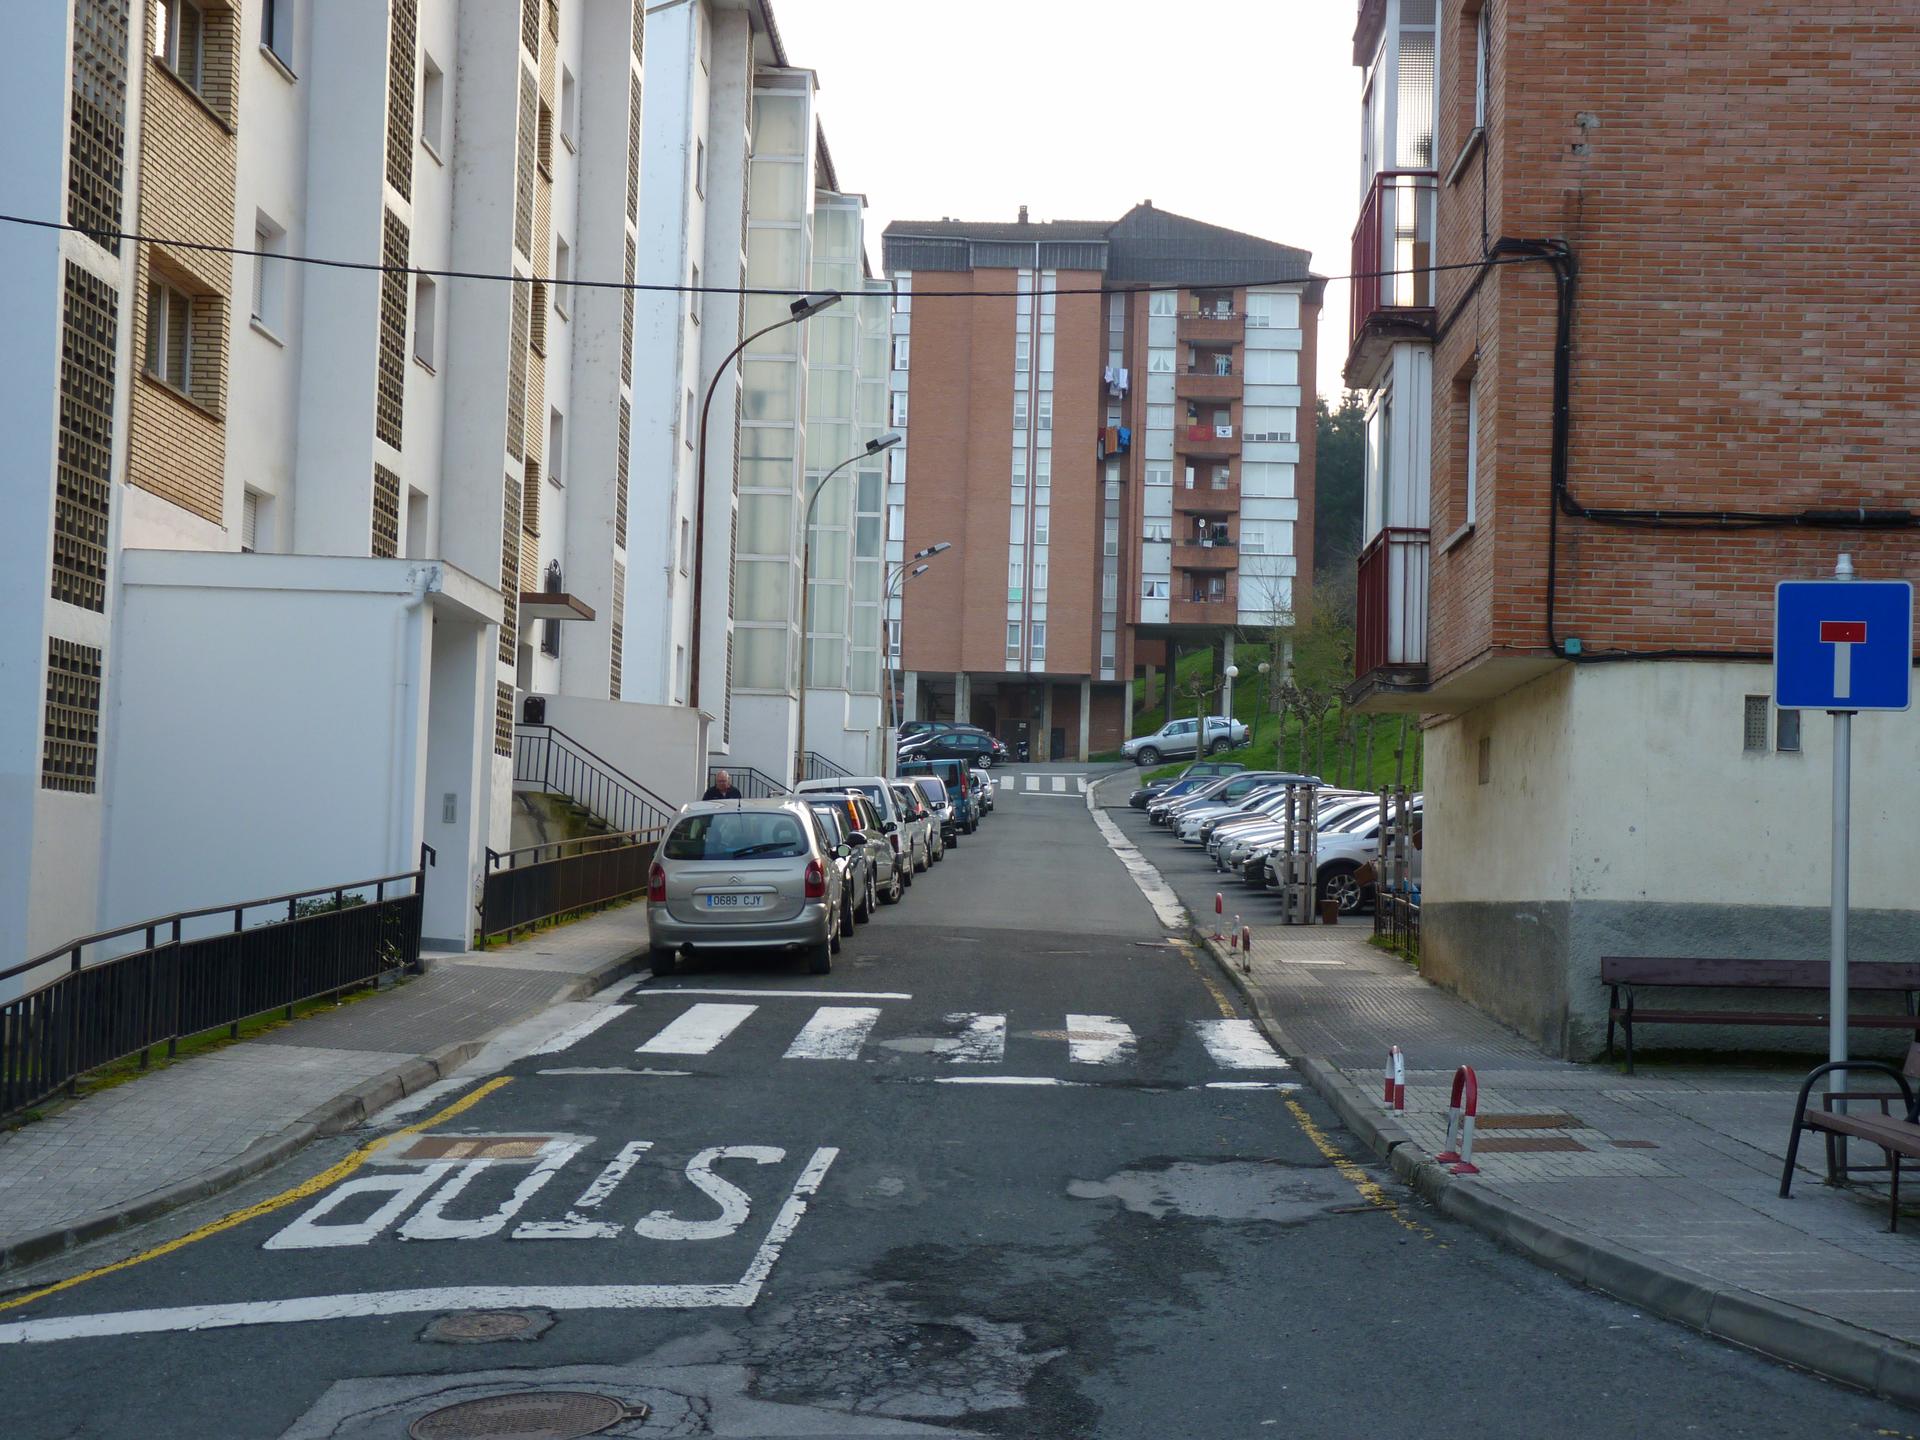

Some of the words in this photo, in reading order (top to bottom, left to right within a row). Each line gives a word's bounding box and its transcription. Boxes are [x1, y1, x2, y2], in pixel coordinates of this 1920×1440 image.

[713, 895, 738, 905] 0689
[743, 895, 761, 905] CJY
[262, 1139, 786, 1249] STOP
